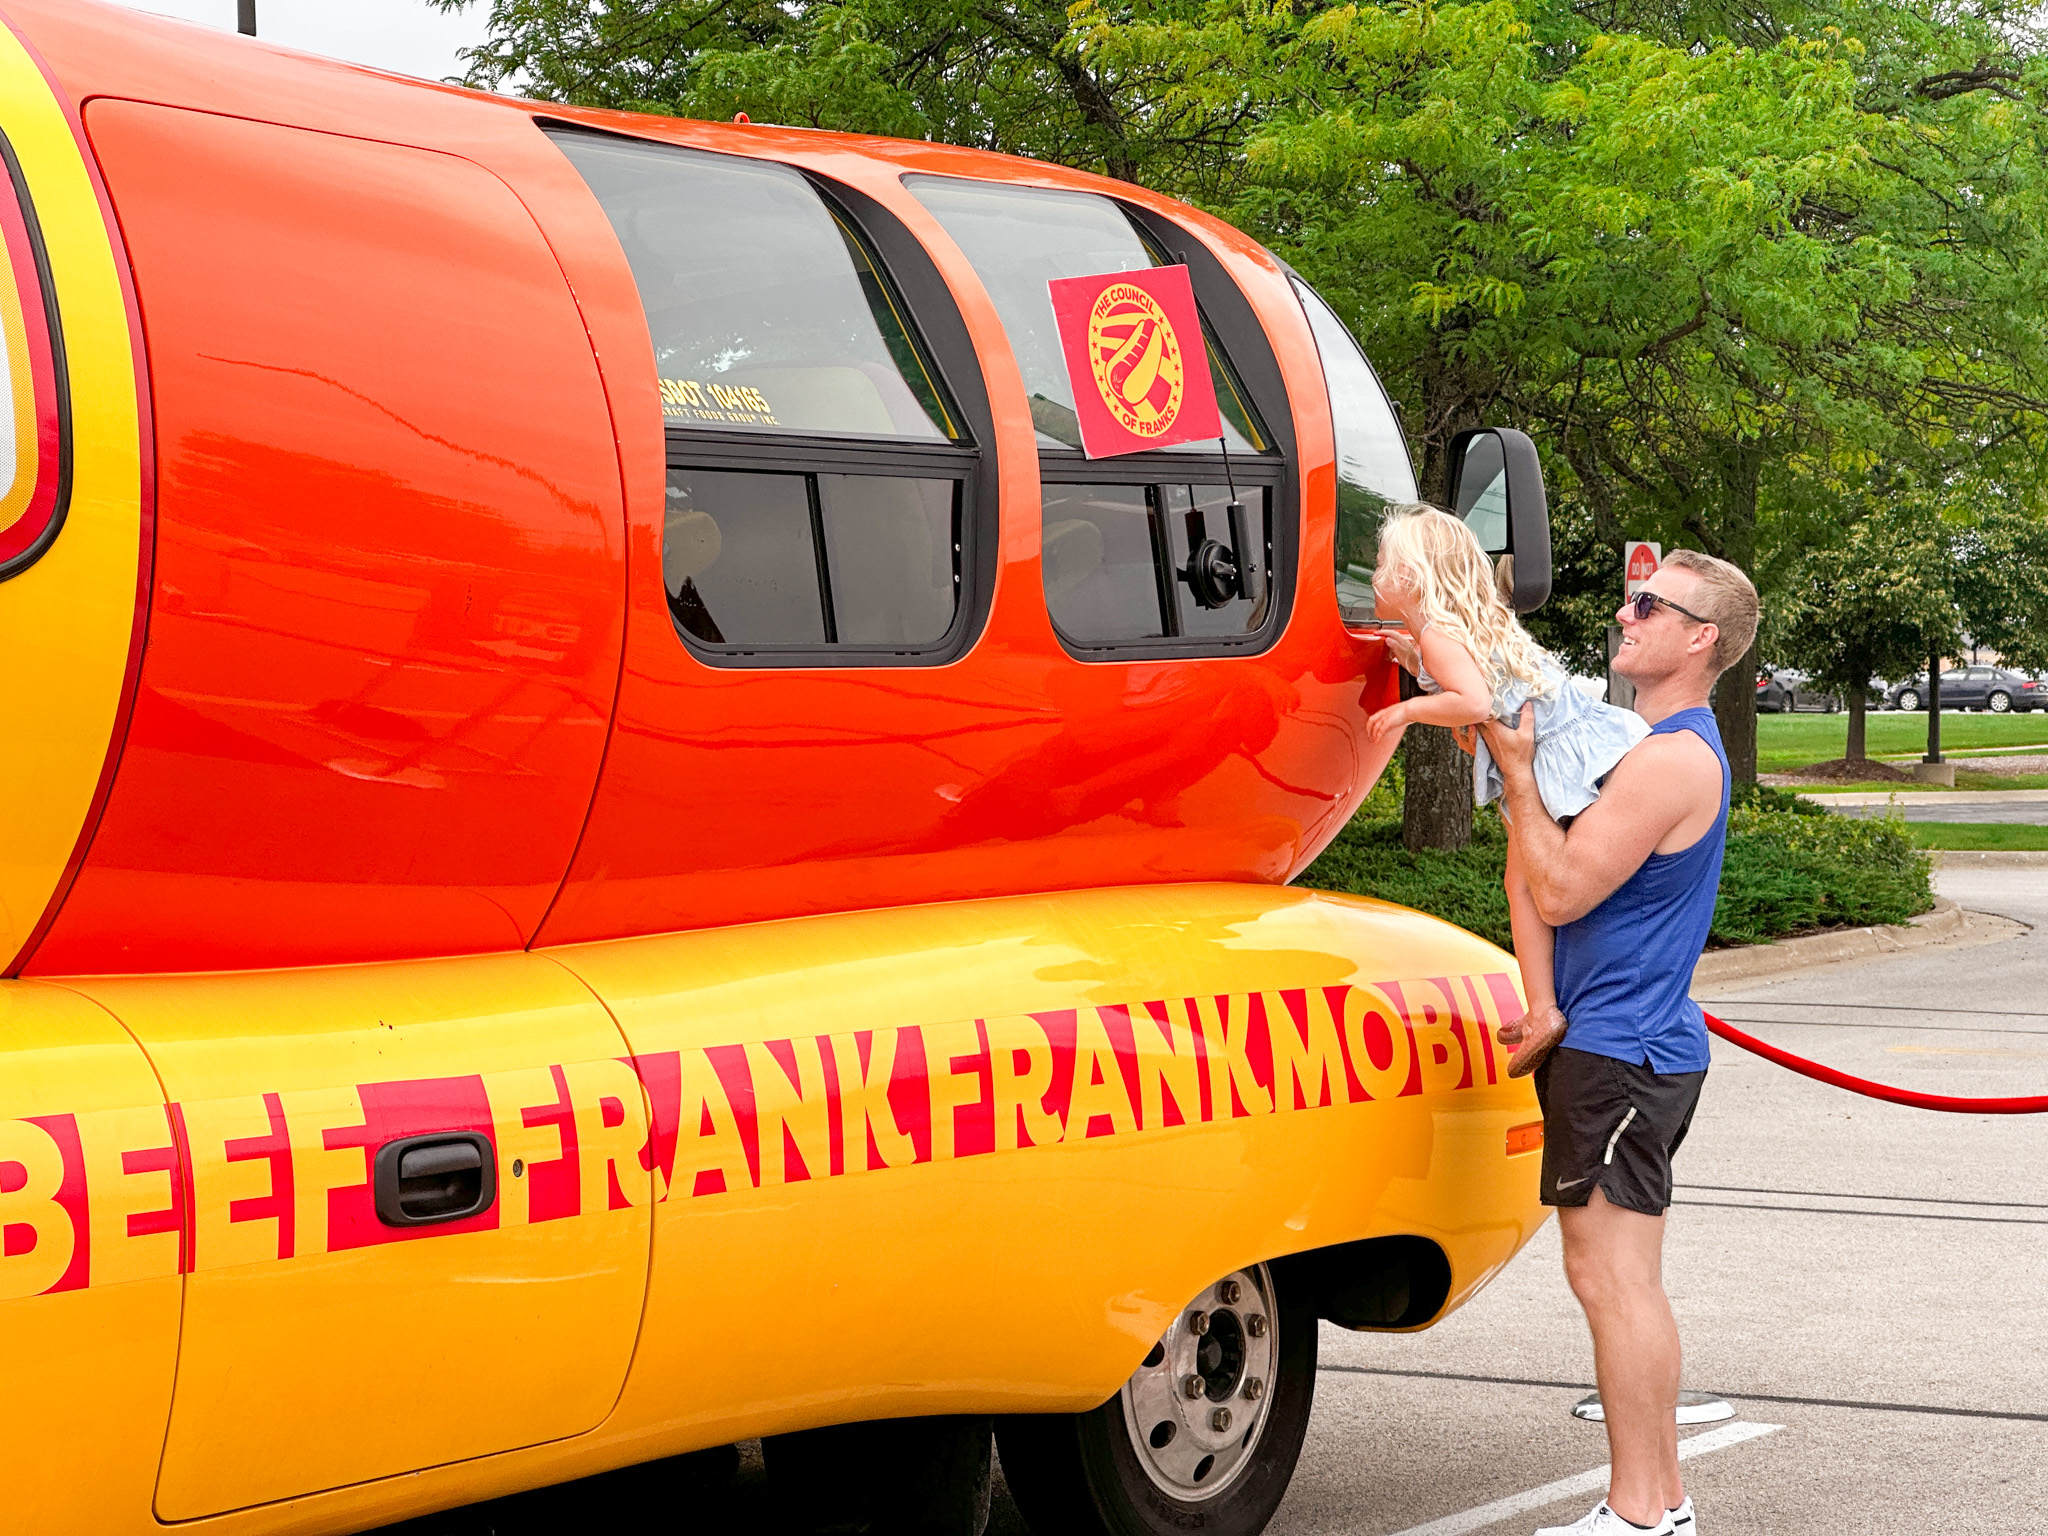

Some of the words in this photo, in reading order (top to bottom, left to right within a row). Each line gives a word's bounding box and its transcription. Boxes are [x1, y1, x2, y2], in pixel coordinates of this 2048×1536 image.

[1094, 295, 1111, 320] THE
[1110, 287, 1154, 315] COUNCIL
[658, 378, 709, 408] SDOT
[706, 382, 771, 414] 104165
[1122, 412, 1137, 430] OF
[1139, 405, 1175, 434] FRANKS
[1632, 562, 1640, 576] DO
[1641, 562, 1654, 576] NOT
[0, 1083, 368, 1298] BEEF
[480, 1027, 918, 1229] FRANK
